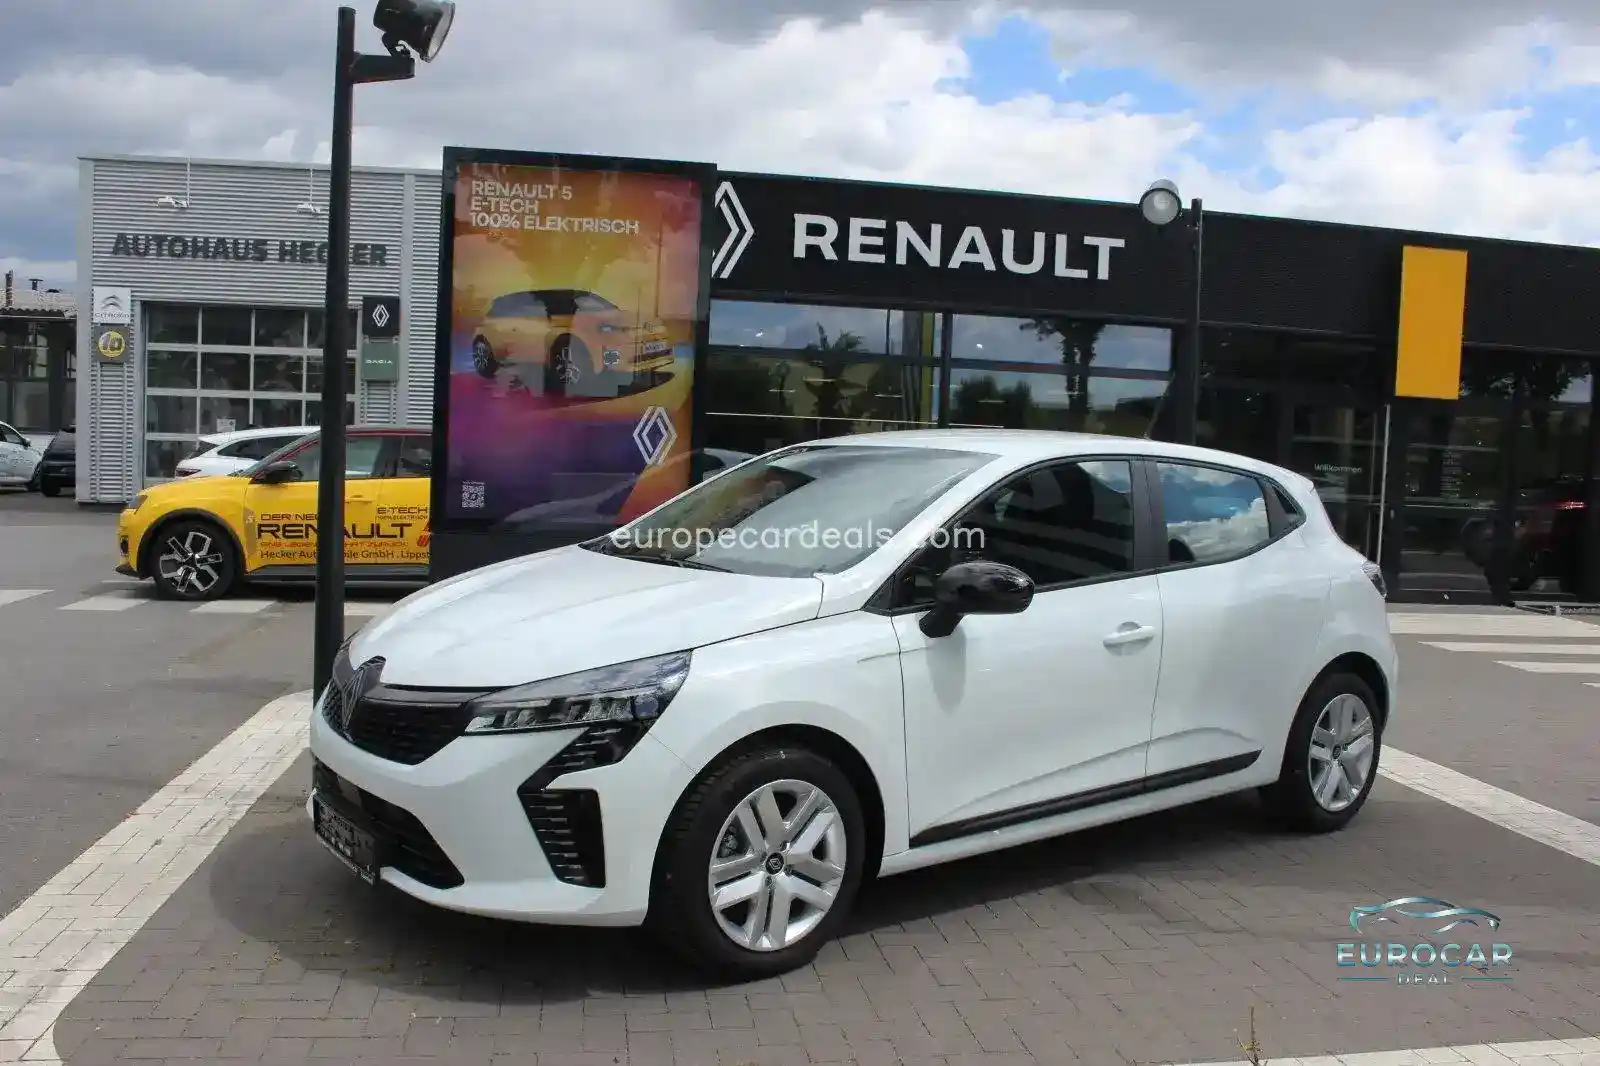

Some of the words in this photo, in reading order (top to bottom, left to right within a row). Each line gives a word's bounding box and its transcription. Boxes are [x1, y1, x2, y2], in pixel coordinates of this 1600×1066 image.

[472, 180, 558, 199] RENAULT
[562, 185, 572, 200] 5
[471, 196, 539, 214] E-TECH
[470, 212, 520, 228] 100%
[524, 215, 640, 233] ELEKTRISCH
[112, 233, 268, 261] AUTOHAUS
[279, 239, 387, 265] HECER
[793, 212, 1126, 281] RENAULT
[261, 513, 292, 521] DER
[377, 506, 428, 514] E-TECH
[260, 550, 297, 559] Hecker
